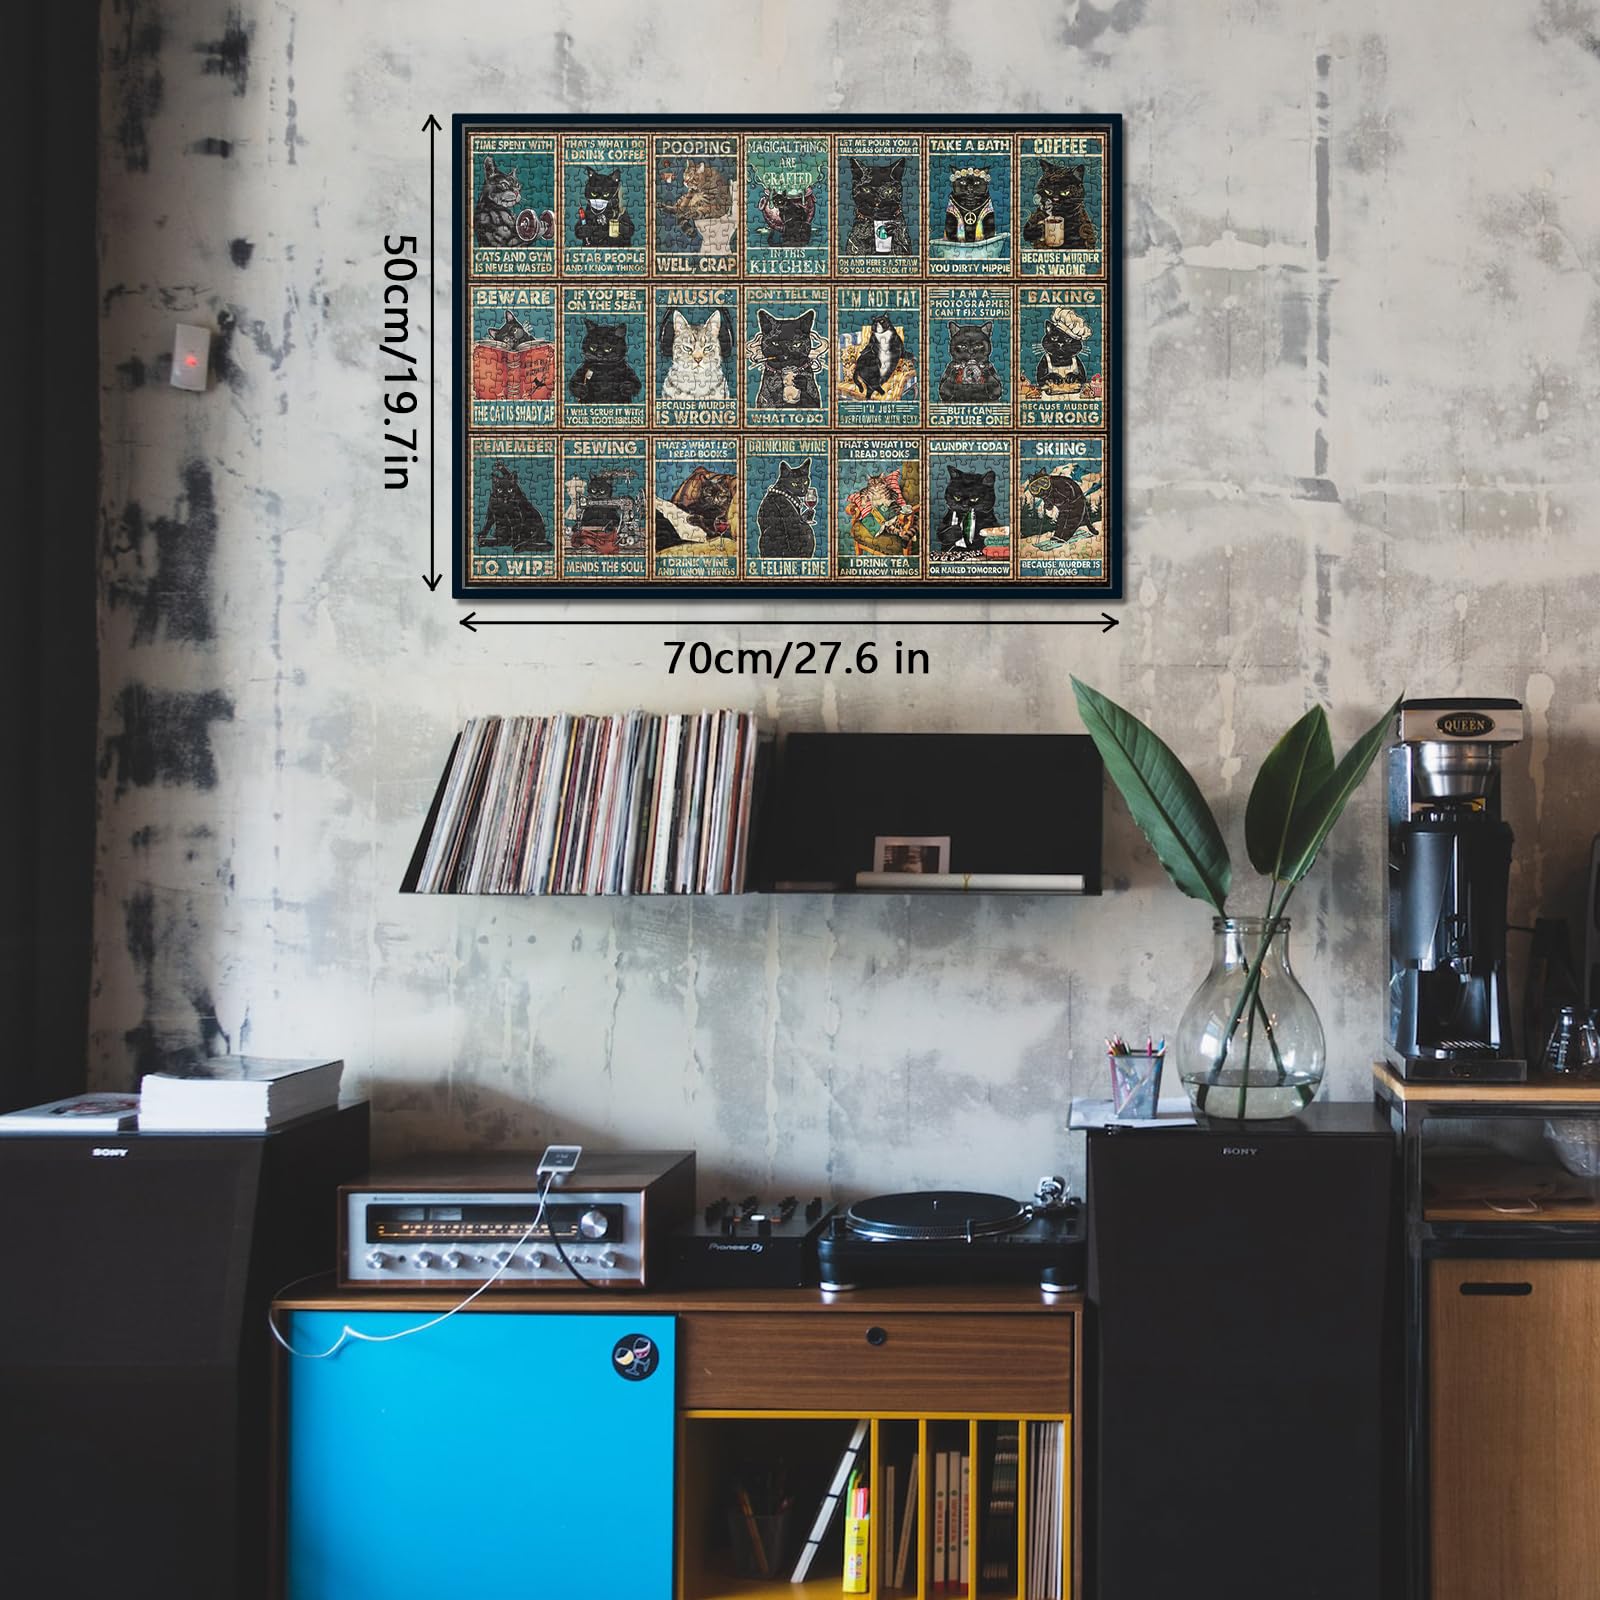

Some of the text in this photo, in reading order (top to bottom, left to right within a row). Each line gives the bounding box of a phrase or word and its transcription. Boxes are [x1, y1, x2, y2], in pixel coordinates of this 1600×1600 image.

[474, 140, 553, 150] TIME SPENT WITH
[565, 140, 595, 149] THAT'S
[597, 140, 624, 149] WHAT
[631, 140, 645, 149] DO
[662, 141, 731, 154] POOPING
[747, 140, 828, 153] MAGICAL THINGS
[930, 140, 1010, 151] TAKE A BATH
[1033, 138, 1088, 154] COFFEE
[571, 149, 605, 160] DRINK
[608, 149, 645, 160] COFFEE
[779, 157, 797, 168] ARE
[762, 172, 813, 186] CRAFTED
[475, 251, 552, 262] CATS AND GYM
[572, 252, 602, 263] STAB
[604, 252, 645, 263] PEOPLE
[770, 249, 806, 258] IN THIS
[1021, 252, 1100, 263] BECAUSE MURDER
[475, 262, 552, 273] IS NEVER WASTED
[699, 257, 737, 272] CRAP
[750, 258, 826, 274] KITCHEN
[930, 263, 1011, 273] YOU DIRTY HIPPIE
[1035, 264, 1086, 275] IS WRONG
[476, 290, 551, 305] BEWARE
[573, 290, 637, 300] IF YOU PEE
[666, 289, 726, 305] MUSIC
[747, 290, 828, 300] DON'T TELL ME
[841, 290, 917, 308] I'M NOT FAT
[959, 289, 978, 298] AM
[982, 289, 990, 298] A
[1027, 290, 1096, 304] BAKING
[567, 300, 643, 311] ON THE SEAT
[929, 300, 1011, 308] PHOTOGRAPHER
[935, 308, 960, 317] CAN'T
[963, 308, 977, 317] FIX
[979, 308, 1011, 317] STUPID
[656, 401, 736, 410] BECAUSE MURDER
[948, 406, 964, 415] BUT
[972, 406, 993, 415] CAN
[1022, 403, 1099, 411] BECAUSE MURDER
[474, 405, 555, 422] THE CAT IS SHADY AF
[656, 410, 736, 425] IS WRONG
[751, 413, 824, 423] WHAT TO DO
[1022, 412, 1099, 424] IS WRONG
[566, 416, 644, 425] YOUR TOOTHBRUSH
[930, 415, 1010, 425] CAPTURE ONE
[474, 441, 554, 453] REMEMBER
[573, 441, 638, 455] SEWING
[688, 441, 715, 450] WHAT
[722, 441, 736, 450] DO
[748, 440, 827, 452] DRINKING WINE
[839, 440, 870, 449] THAT'S
[871, 440, 898, 449] WHAT
[906, 440, 919, 449] DO
[929, 441, 1010, 451] LAUNDRY TODAY
[1035, 442, 1087, 456] SKIING
[673, 450, 697, 458] READ
[698, 450, 728, 458] BOOKS
[854, 450, 878, 458] READ
[879, 450, 910, 458] BOOKS
[474, 560, 554, 575] TO WIPE
[566, 561, 645, 573] MENDS THE SOUL
[668, 558, 700, 567] DRINK
[702, 558, 729, 567] WINE
[761, 561, 798, 575] FELINE
[801, 561, 826, 575] FINE
[856, 558, 888, 568] DRINK
[890, 558, 910, 568] TEA
[1021, 560, 1100, 569] BECAUSE MURDER IS
[657, 567, 675, 576] AND
[680, 567, 705, 576] KNOW
[706, 567, 735, 576] THINGS
[839, 568, 858, 576] AND
[863, 568, 888, 576] KNOW
[889, 568, 919, 576] THINGS
[929, 565, 1010, 575] OR NAKED TOMORROW
[1045, 568, 1078, 577] WRONG
[1444, 719, 1485, 732] QUEEN
[93, 1148, 129, 1157] SONY
